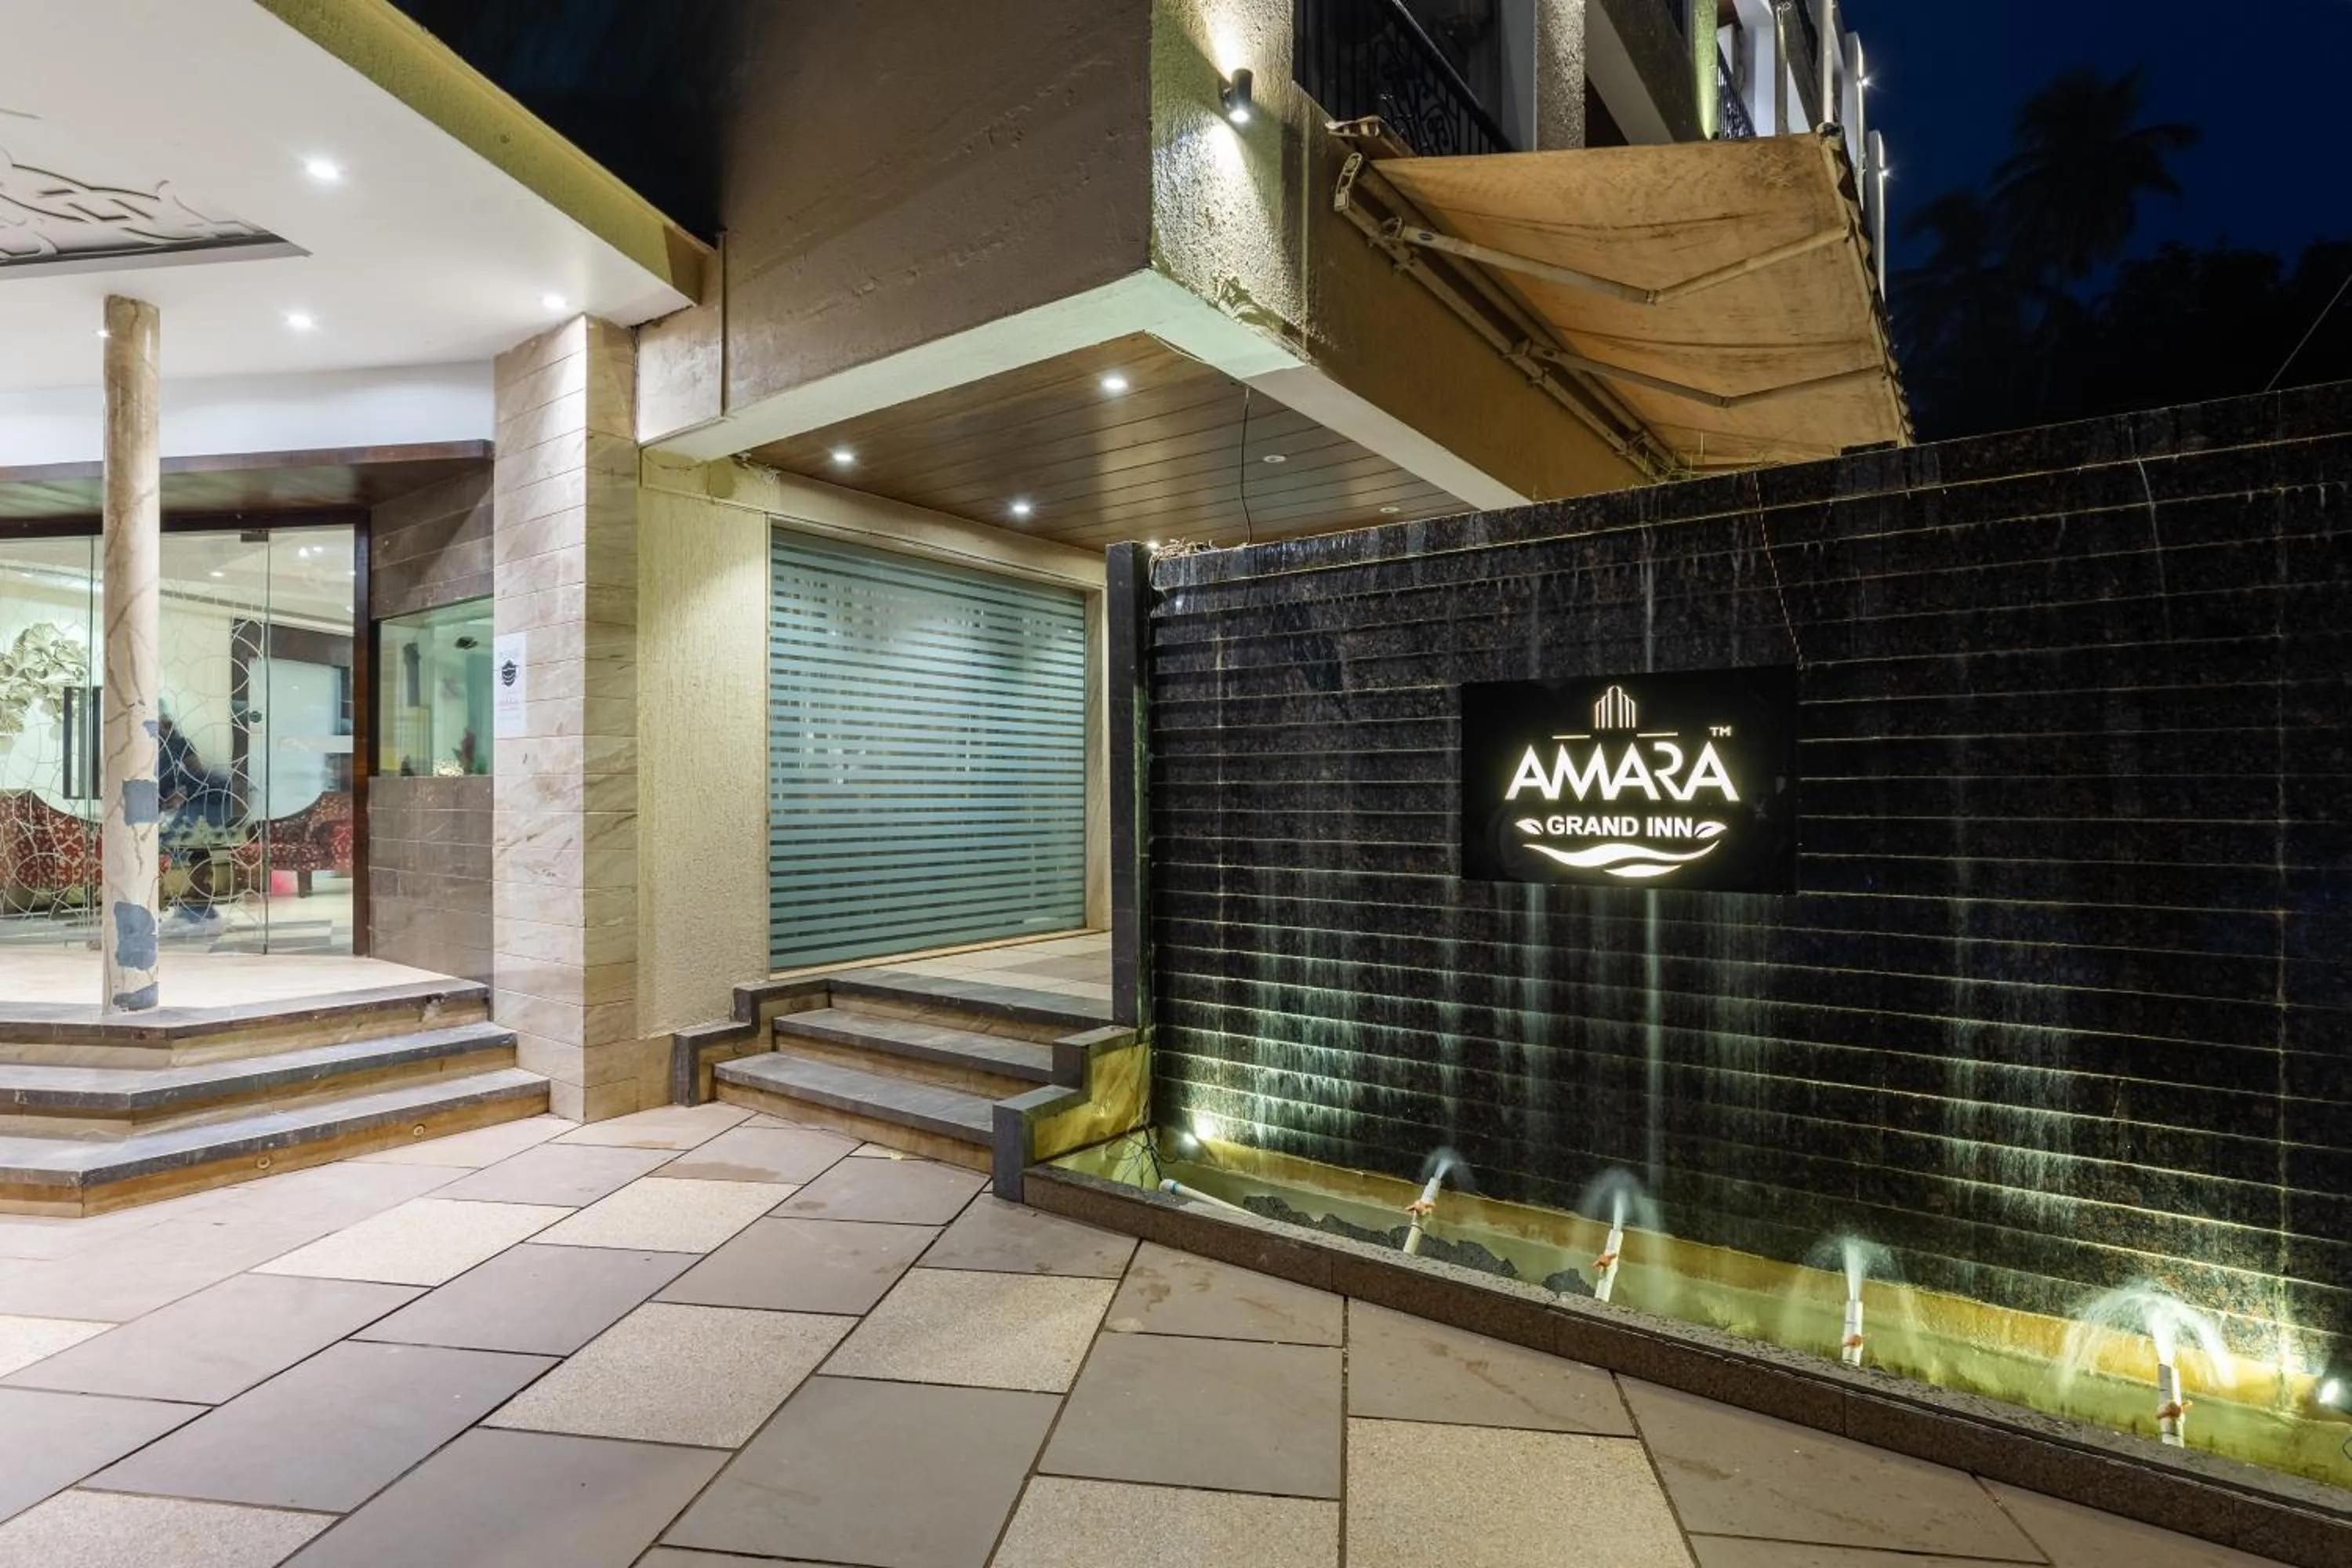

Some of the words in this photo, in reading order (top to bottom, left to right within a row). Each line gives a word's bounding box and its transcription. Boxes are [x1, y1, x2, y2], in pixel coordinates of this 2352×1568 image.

[1504, 741, 1740, 800] AMARA
[1546, 815, 1639, 837] GRAND
[1646, 816, 1693, 837] INN
